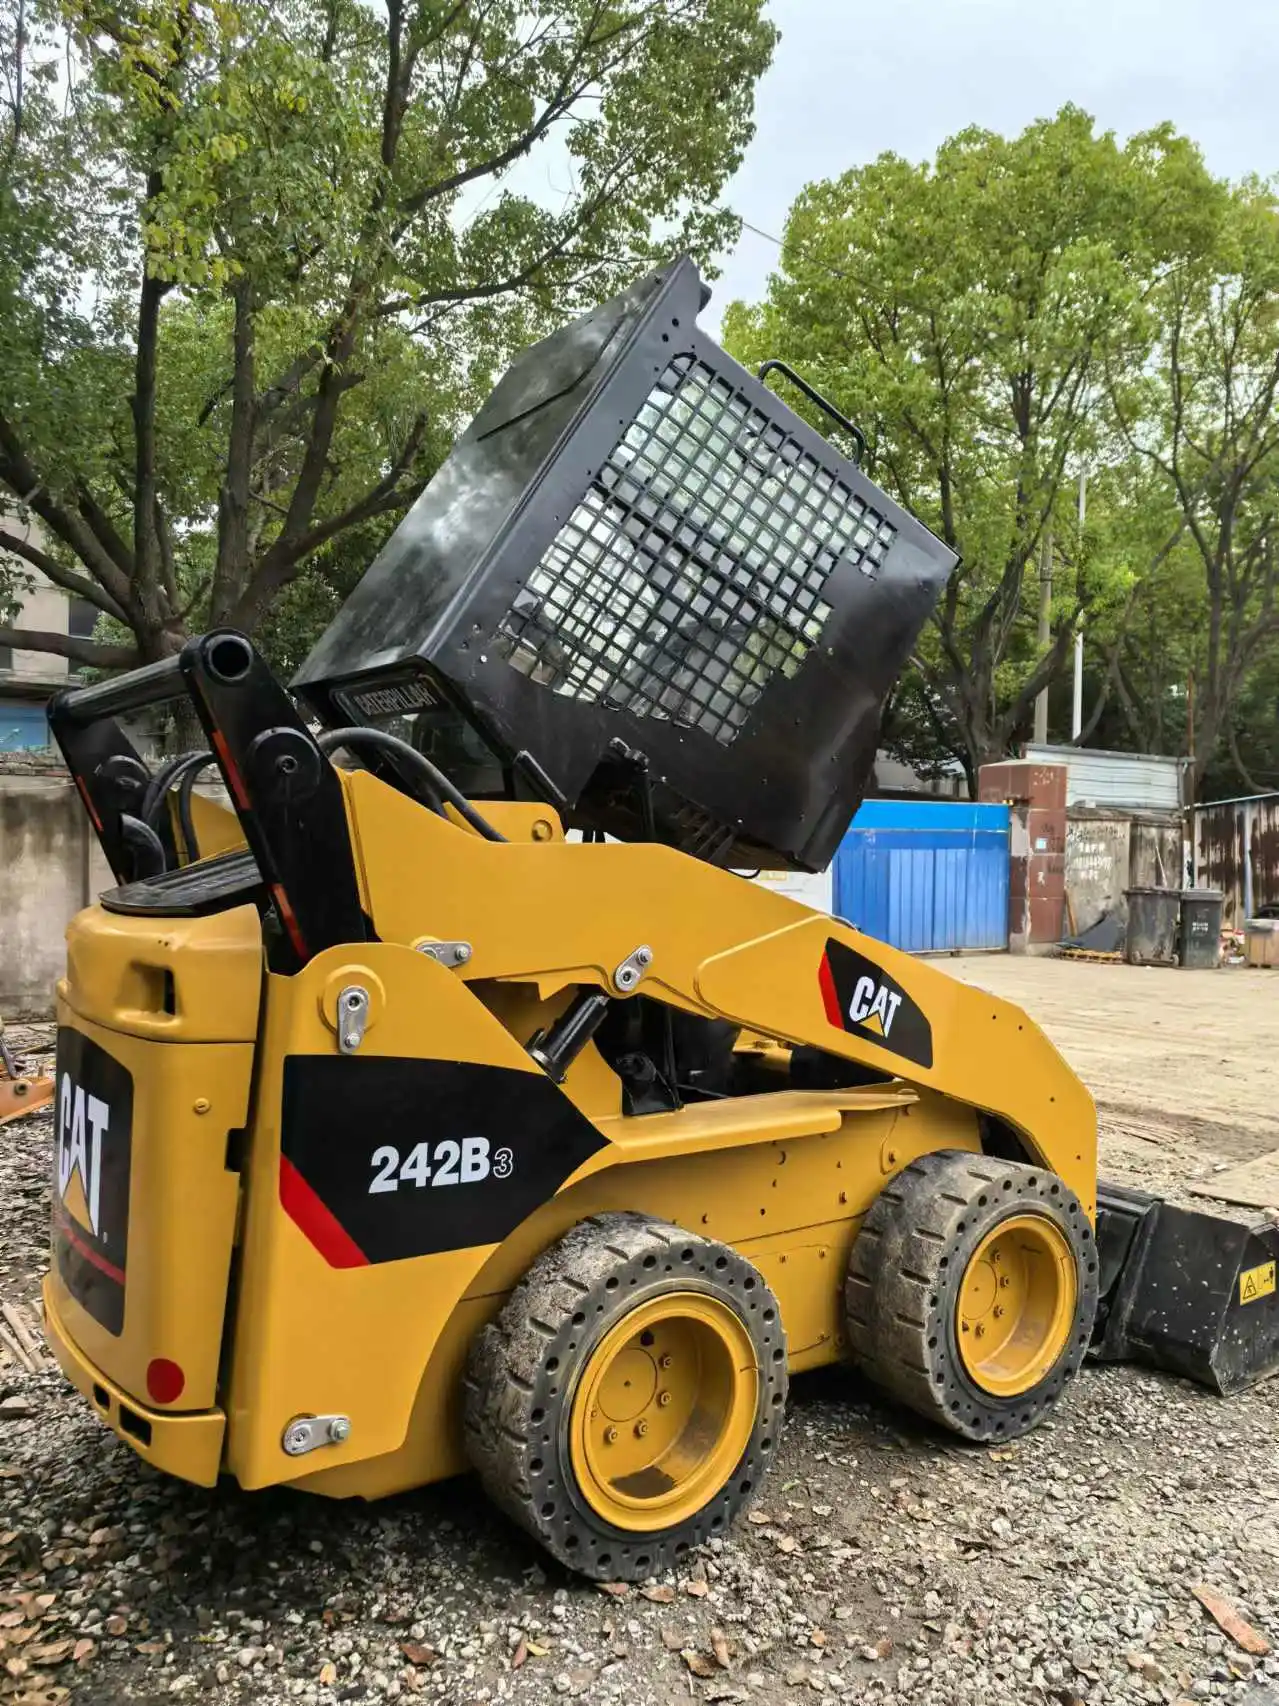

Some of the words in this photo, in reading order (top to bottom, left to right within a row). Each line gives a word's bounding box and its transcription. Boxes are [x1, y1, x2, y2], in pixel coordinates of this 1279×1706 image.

[353, 682, 438, 716] CATERPILLAR
[849, 975, 902, 1038] CAT
[58, 1071, 109, 1237] CAT
